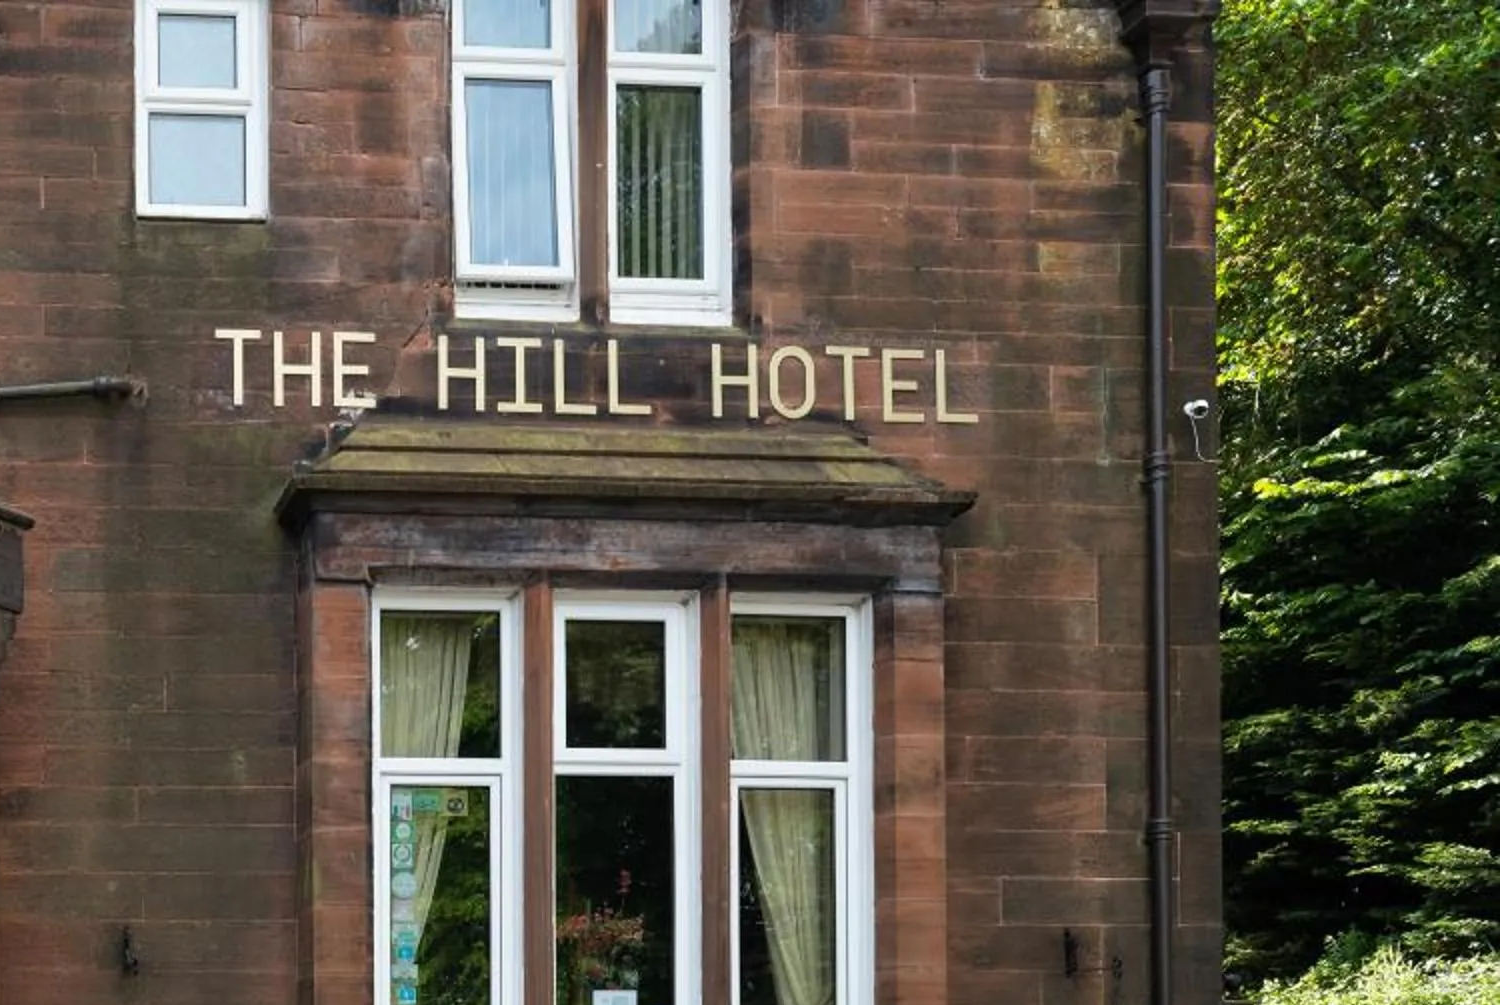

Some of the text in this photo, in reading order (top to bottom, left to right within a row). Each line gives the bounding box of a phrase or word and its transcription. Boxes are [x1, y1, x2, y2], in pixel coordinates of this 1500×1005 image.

[214, 329, 979, 424] THE HILL HOTEL
